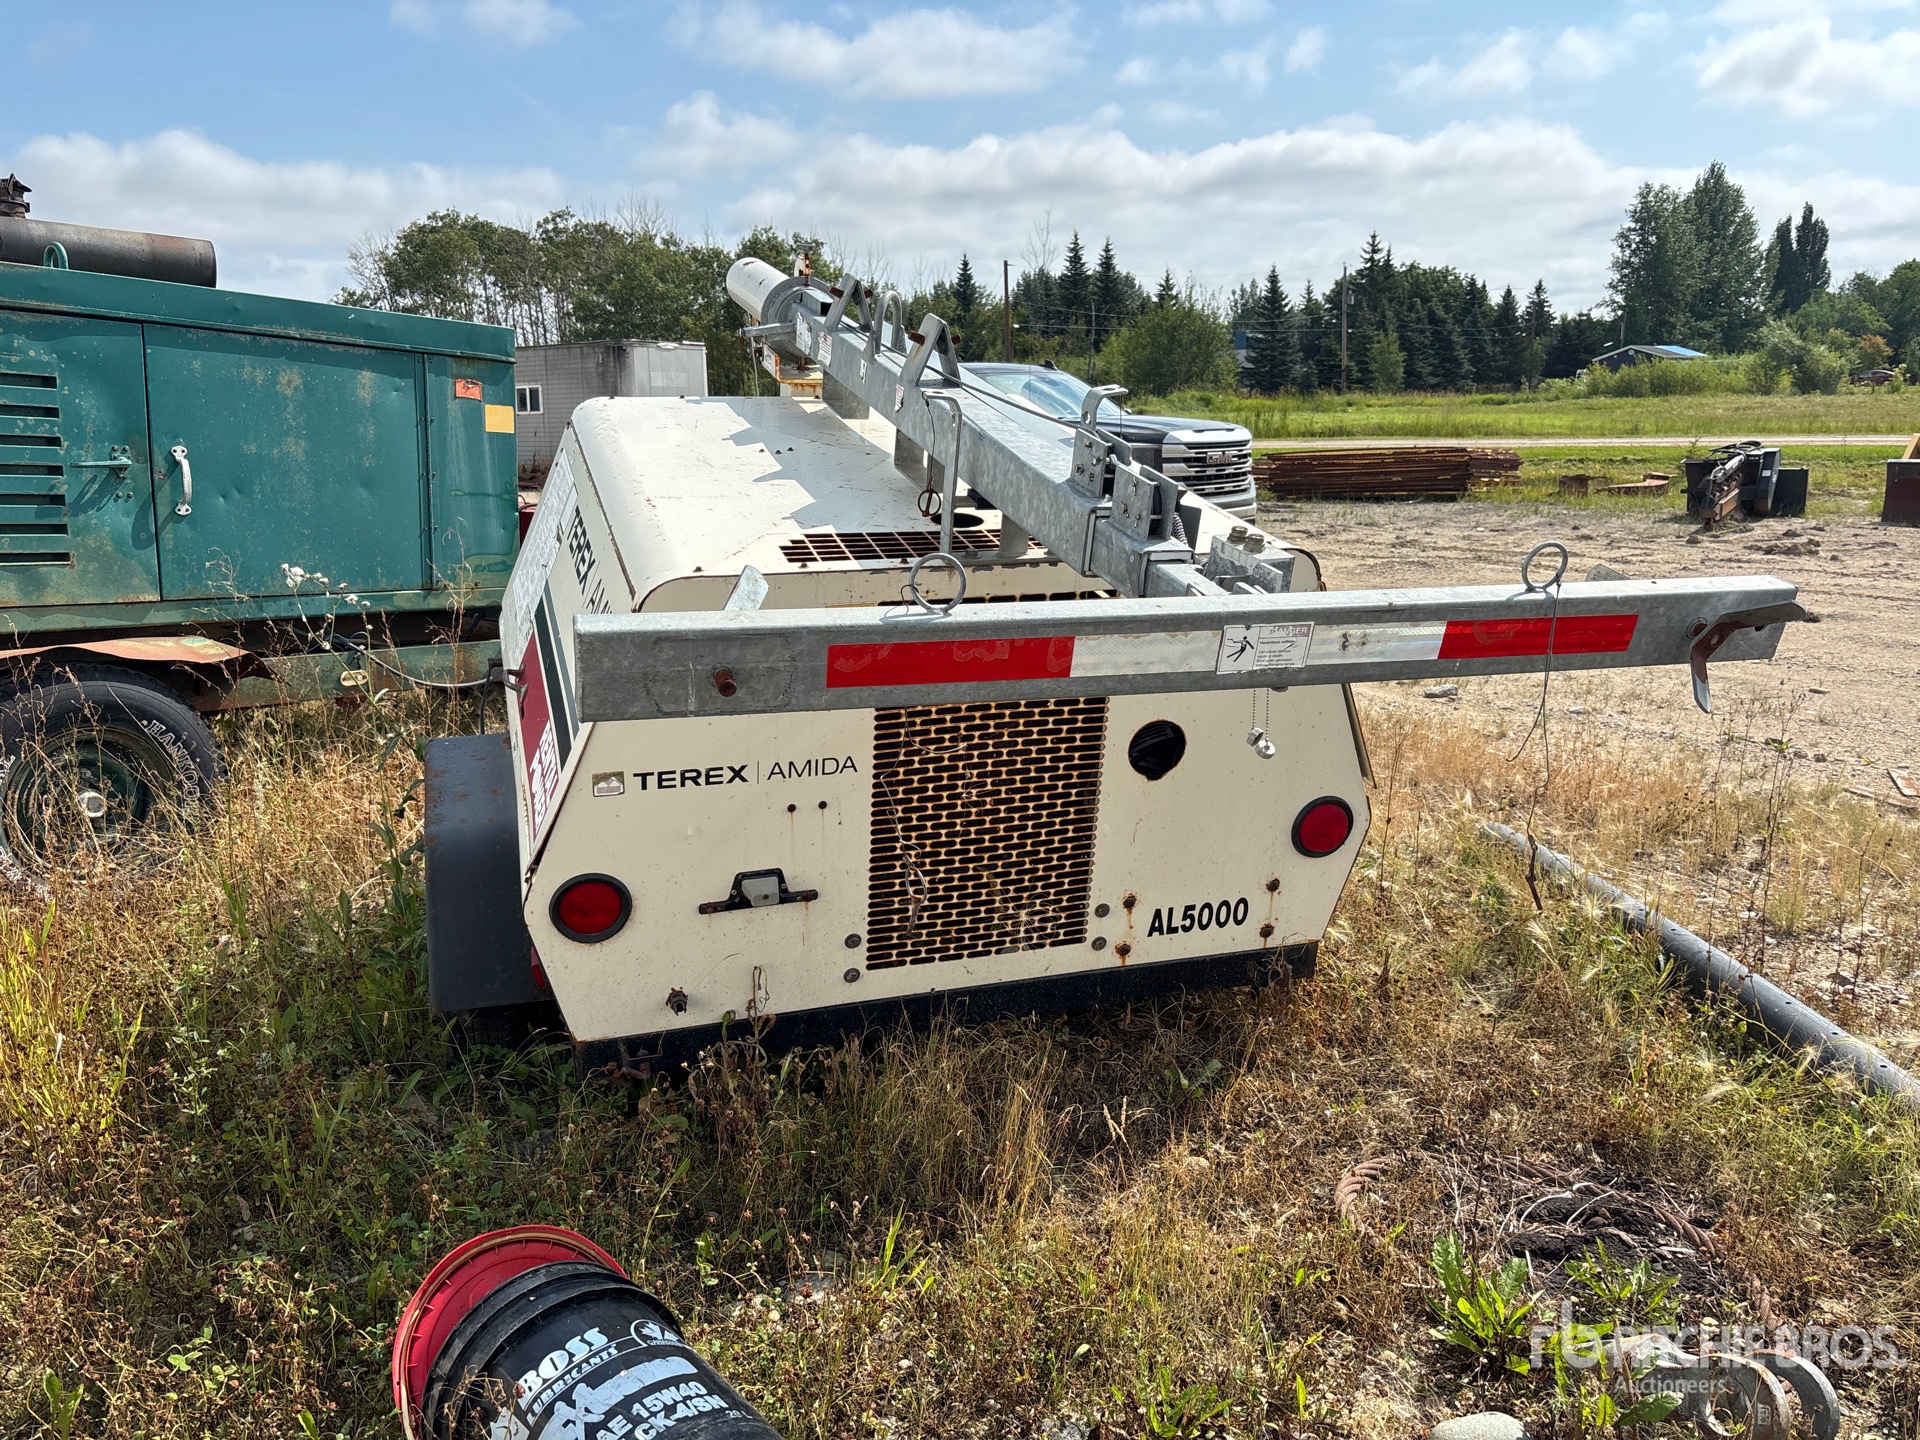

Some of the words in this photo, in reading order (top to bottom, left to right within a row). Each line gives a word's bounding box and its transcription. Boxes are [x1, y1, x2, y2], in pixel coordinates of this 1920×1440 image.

[1207, 451, 1239, 464] GMC
[567, 505, 596, 595] TEREX
[539, 719, 560, 811] RENTAL
[633, 764, 749, 791] TEREX
[767, 755, 858, 781] AMIDA
[1147, 897, 1249, 938] AL5000
[516, 1327, 609, 1412] BOSS
[526, 1343, 619, 1427] LUBRICANTS
